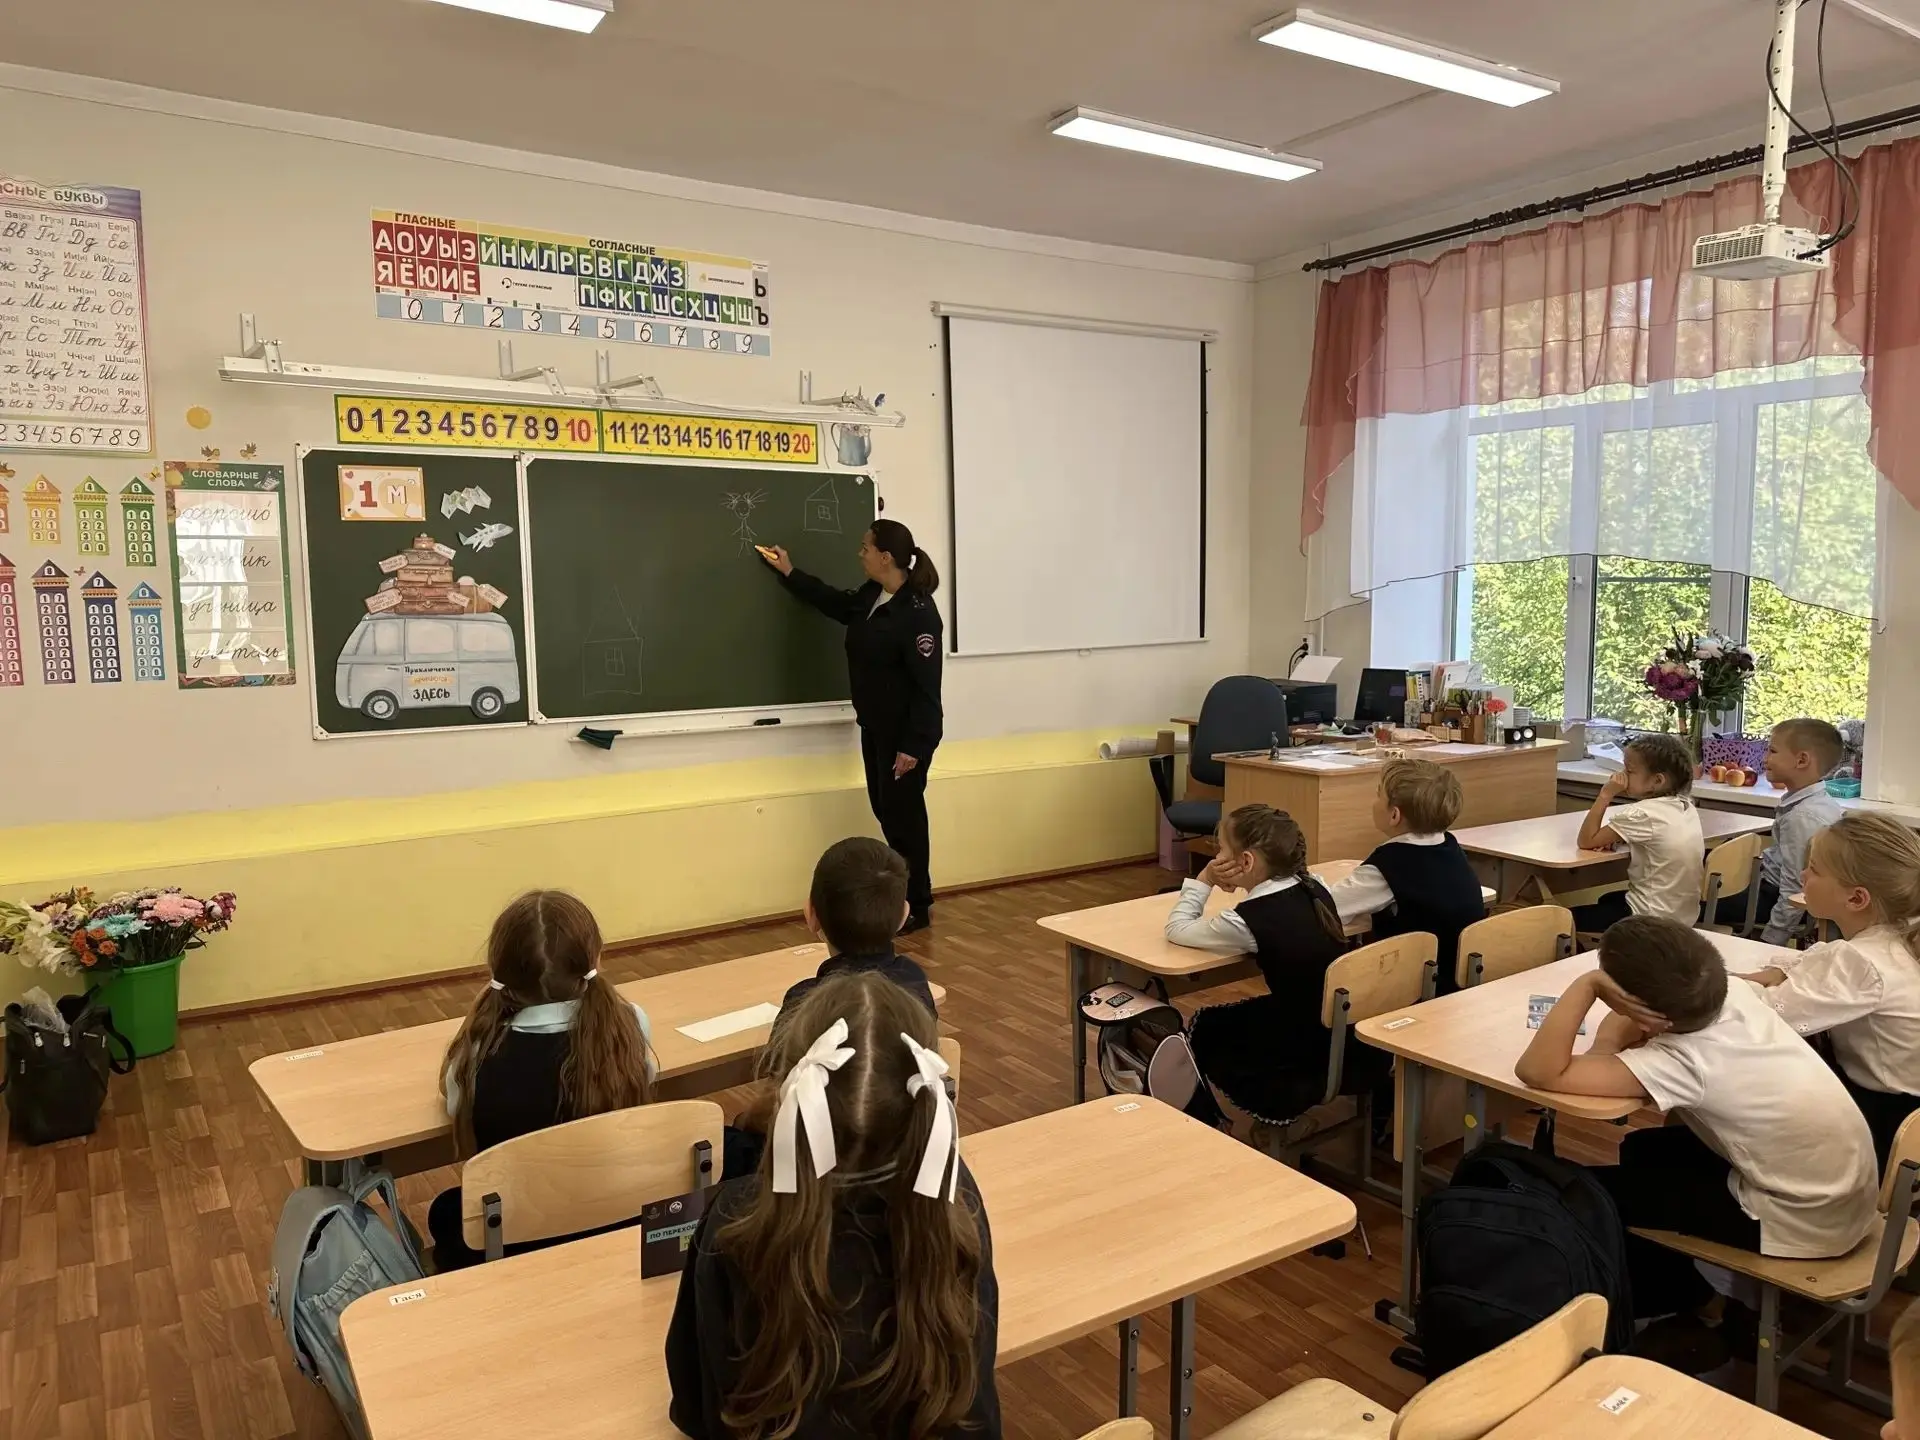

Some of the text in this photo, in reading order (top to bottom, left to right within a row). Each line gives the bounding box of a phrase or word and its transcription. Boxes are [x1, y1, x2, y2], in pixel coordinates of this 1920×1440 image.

[0, 182, 103, 204] СНЫЕ БУКВЫ
[395, 212, 456, 228] ГЛАСНЫЕ
[590, 239, 655, 255] СОГЛАСНЫЕ
[408, 299, 753, 353] 0 1 2 3 4 5 6 7 8 9
[14, 424, 26, 441] 3
[32, 425, 45, 442] 4
[50, 426, 65, 443] 5
[70, 427, 83, 444] 6
[89, 428, 103, 444] 7
[109, 428, 122, 445] 8
[127, 430, 140, 446] 9
[347, 407, 591, 442] 0 1 2 3 4 5 6 7 8 9 10
[610, 421, 810, 454] 11 12 13 14 15 16 17 18 19 20
[192, 470, 259, 479] СЛОВАРНЫЕ
[208, 479, 245, 487] СЛОВА
[360, 481, 407, 507] 1 М
[413, 688, 450, 701] ЗДЕСЬ
